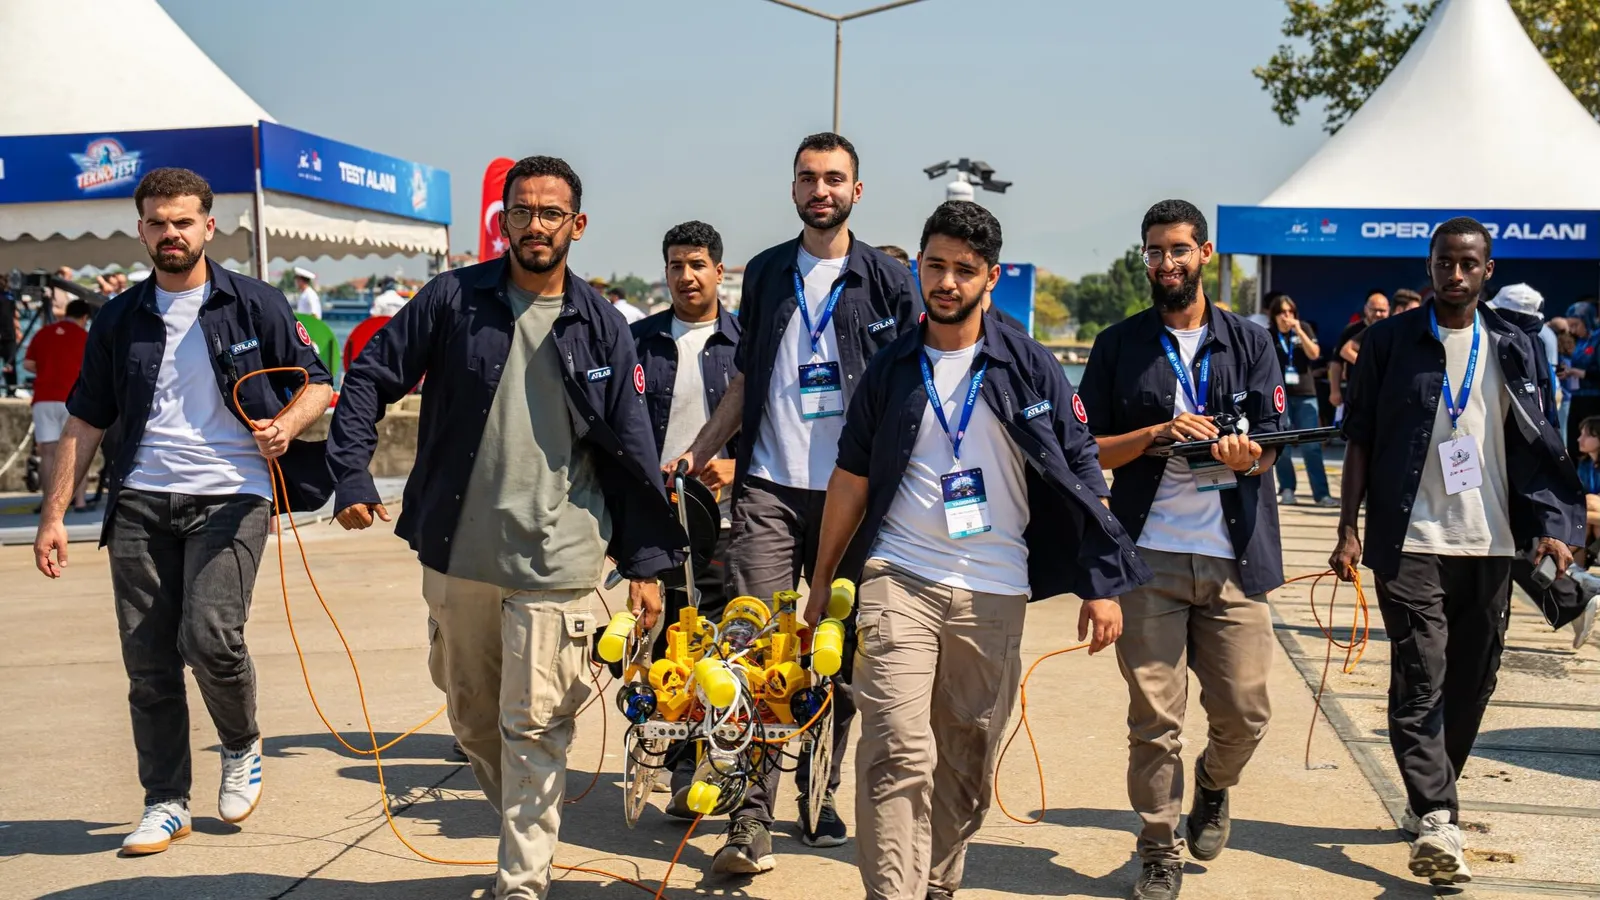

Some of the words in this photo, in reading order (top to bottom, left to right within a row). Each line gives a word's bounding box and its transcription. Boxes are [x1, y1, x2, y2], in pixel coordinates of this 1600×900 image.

[76, 159, 139, 190] TEKNOFEST
[338, 161, 366, 187] TEST
[366, 169, 397, 194] ALANI
[1361, 222, 1499, 239] OPERR
[1502, 223, 1587, 240] ALANI
[966, 380, 979, 406] VATAN
